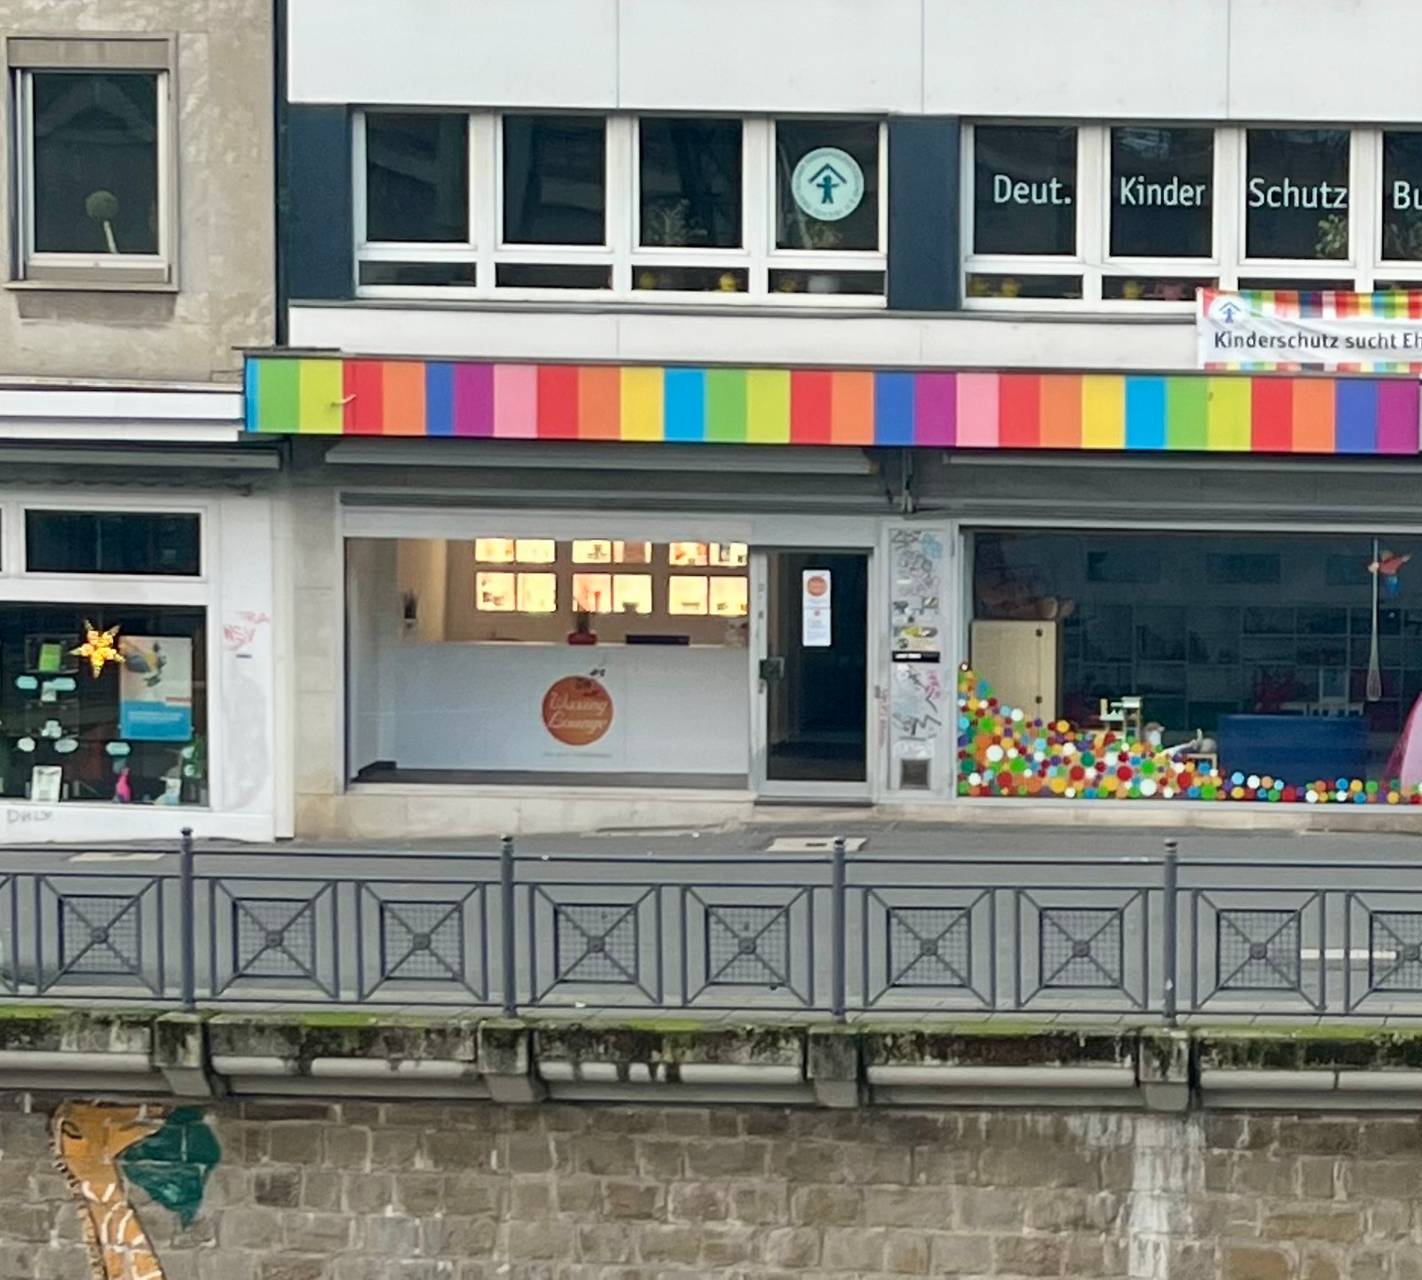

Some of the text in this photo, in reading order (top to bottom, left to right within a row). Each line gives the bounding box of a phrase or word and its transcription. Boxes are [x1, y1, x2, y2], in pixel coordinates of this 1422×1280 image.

[993, 175, 1072, 205] Deut.
[1120, 176, 1206, 207] Kinder
[1248, 177, 1348, 210] Schutz
[1214, 330, 1339, 349] Kinderschutz
[1345, 331, 1398, 349] sucht
